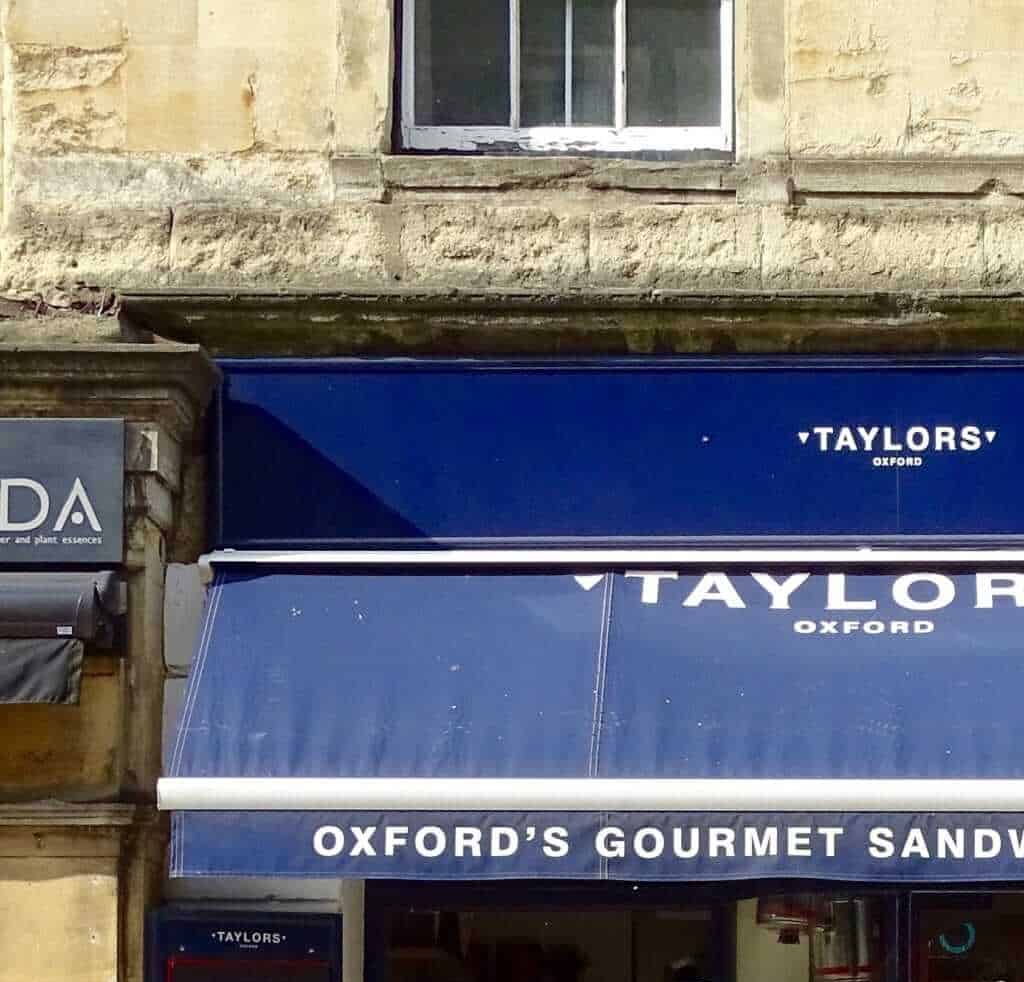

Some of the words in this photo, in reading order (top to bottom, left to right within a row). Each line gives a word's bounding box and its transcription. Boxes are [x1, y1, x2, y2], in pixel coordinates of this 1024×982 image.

[814, 426, 981, 451] TAYLORS
[872, 456, 922, 467] OXFORD
[15, 535, 30, 545] and
[34, 535, 58, 547] plant
[62, 536, 102, 545] essences
[793, 620, 935, 634] OXFORD
[313, 826, 569, 859] OXFORD'S
[595, 826, 844, 859] GOURMET
[216, 931, 281, 944] TAYLORS
